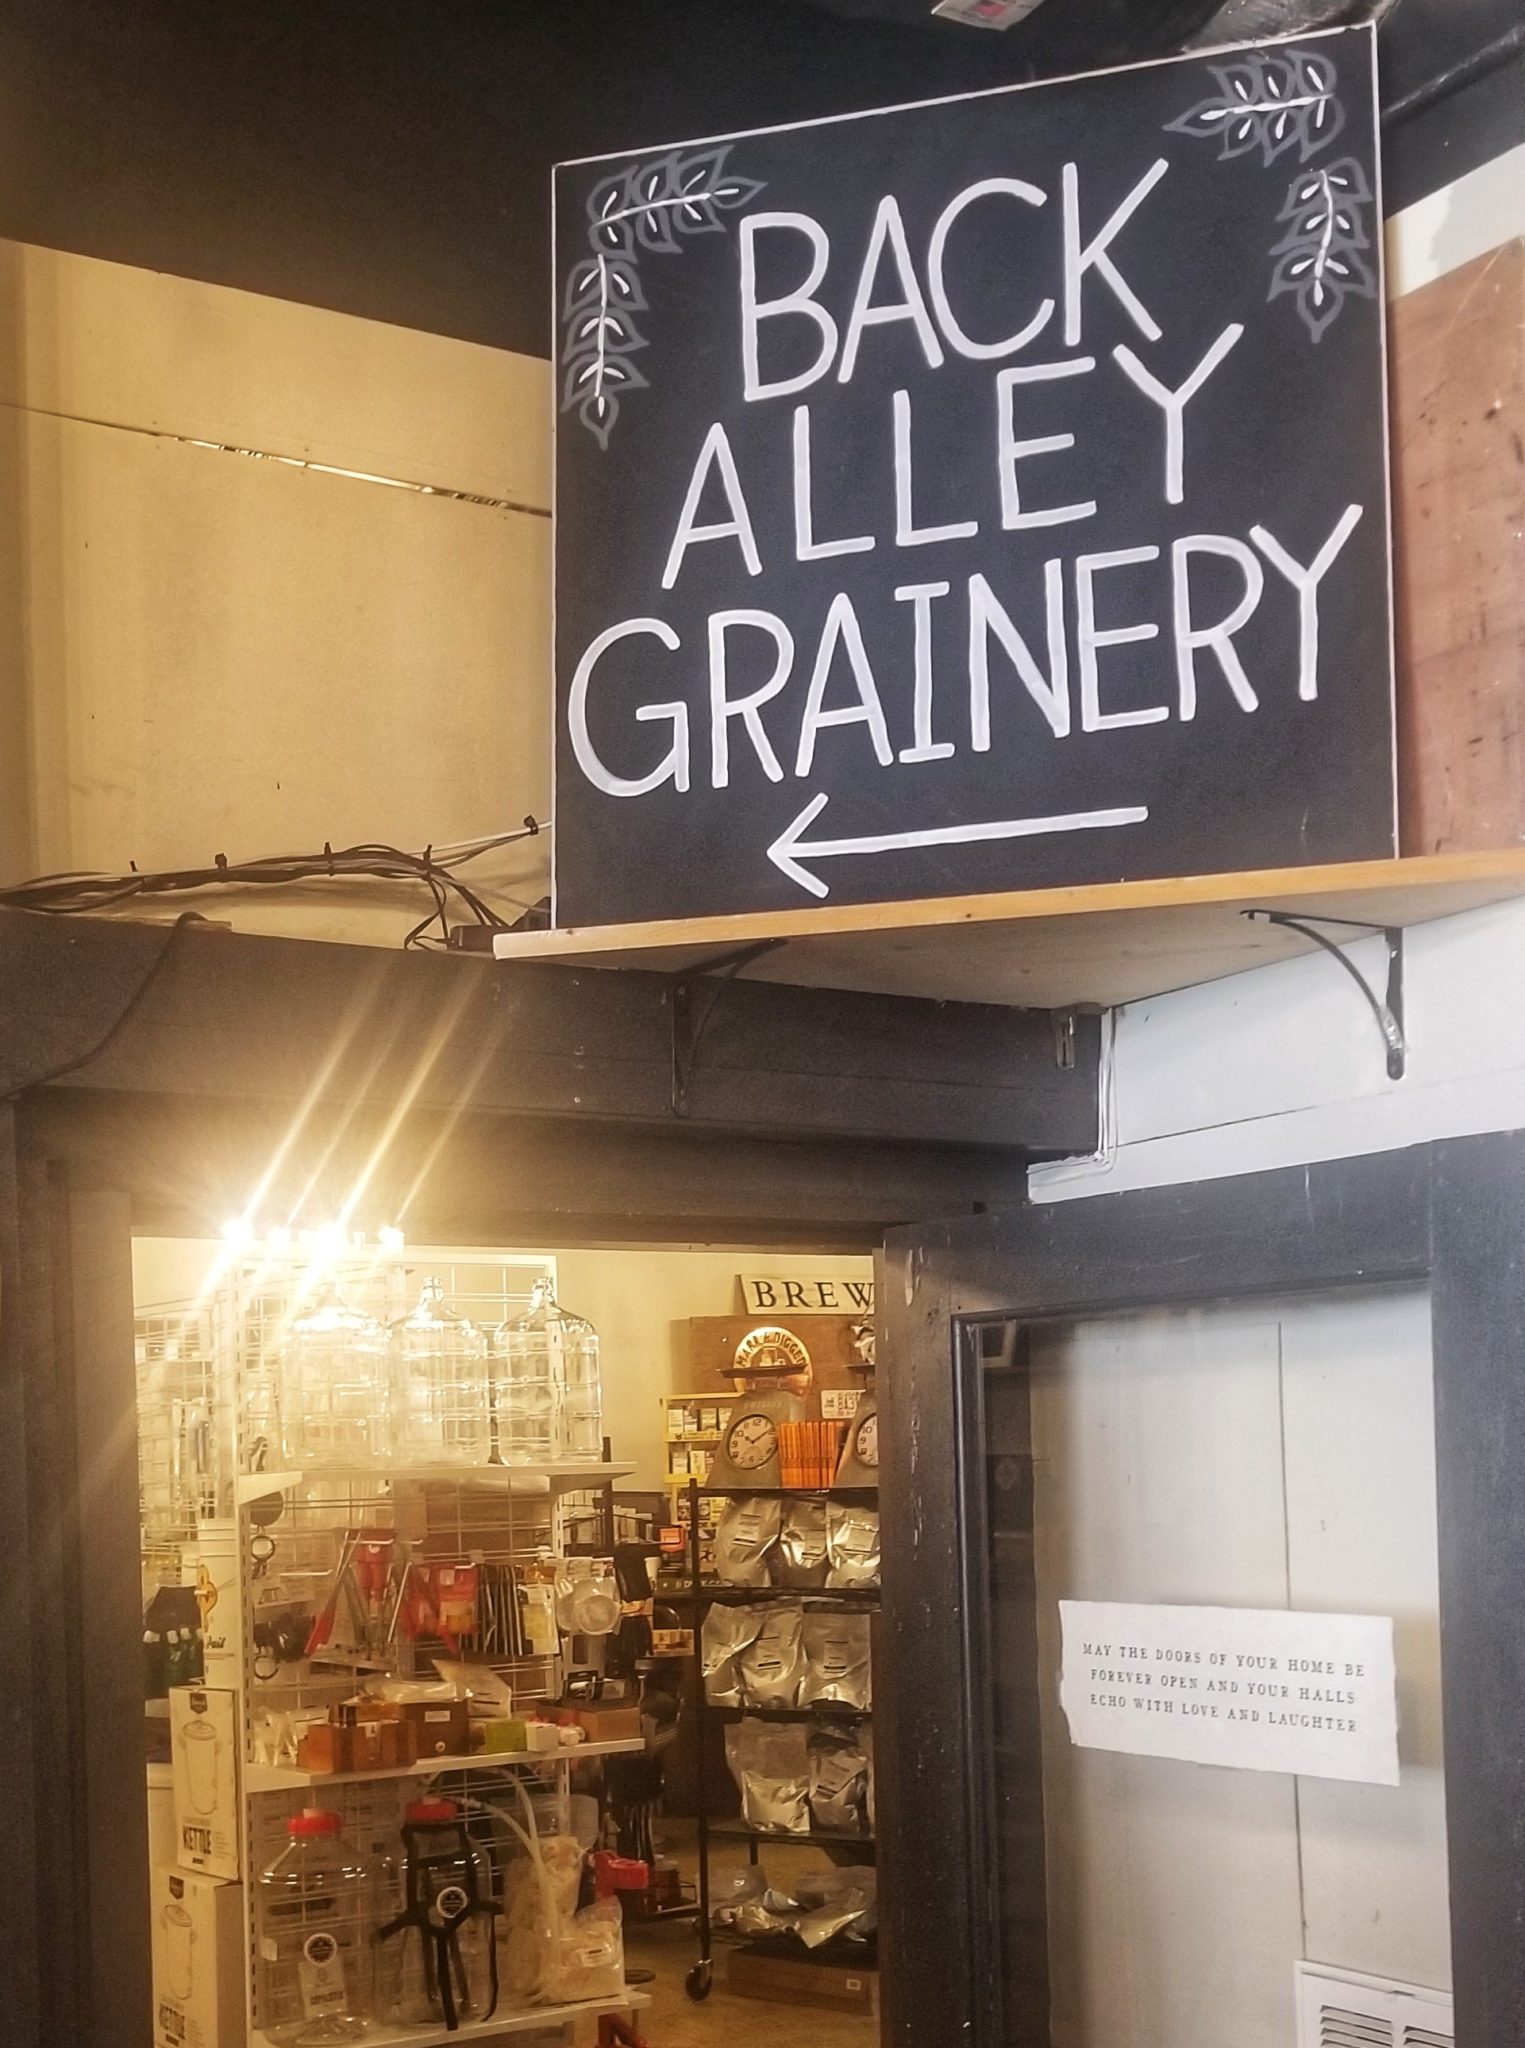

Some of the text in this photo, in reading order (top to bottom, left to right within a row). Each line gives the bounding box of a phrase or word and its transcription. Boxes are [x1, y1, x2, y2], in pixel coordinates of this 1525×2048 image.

[739, 158, 1169, 403] BACK
[661, 323, 1245, 590] ALLEY
[567, 503, 1364, 797] GRAINERY
[751, 1280, 875, 1308] BREW
[1083, 1643, 1365, 1677] MAY THE DOORS OF YOUR HOME BE
[1091, 1669, 1356, 1704] FOREVER OPEN AND YOUR HALLS
[1090, 1694, 1357, 1732] ECHO WITH LOVE AND LAUGHTER
